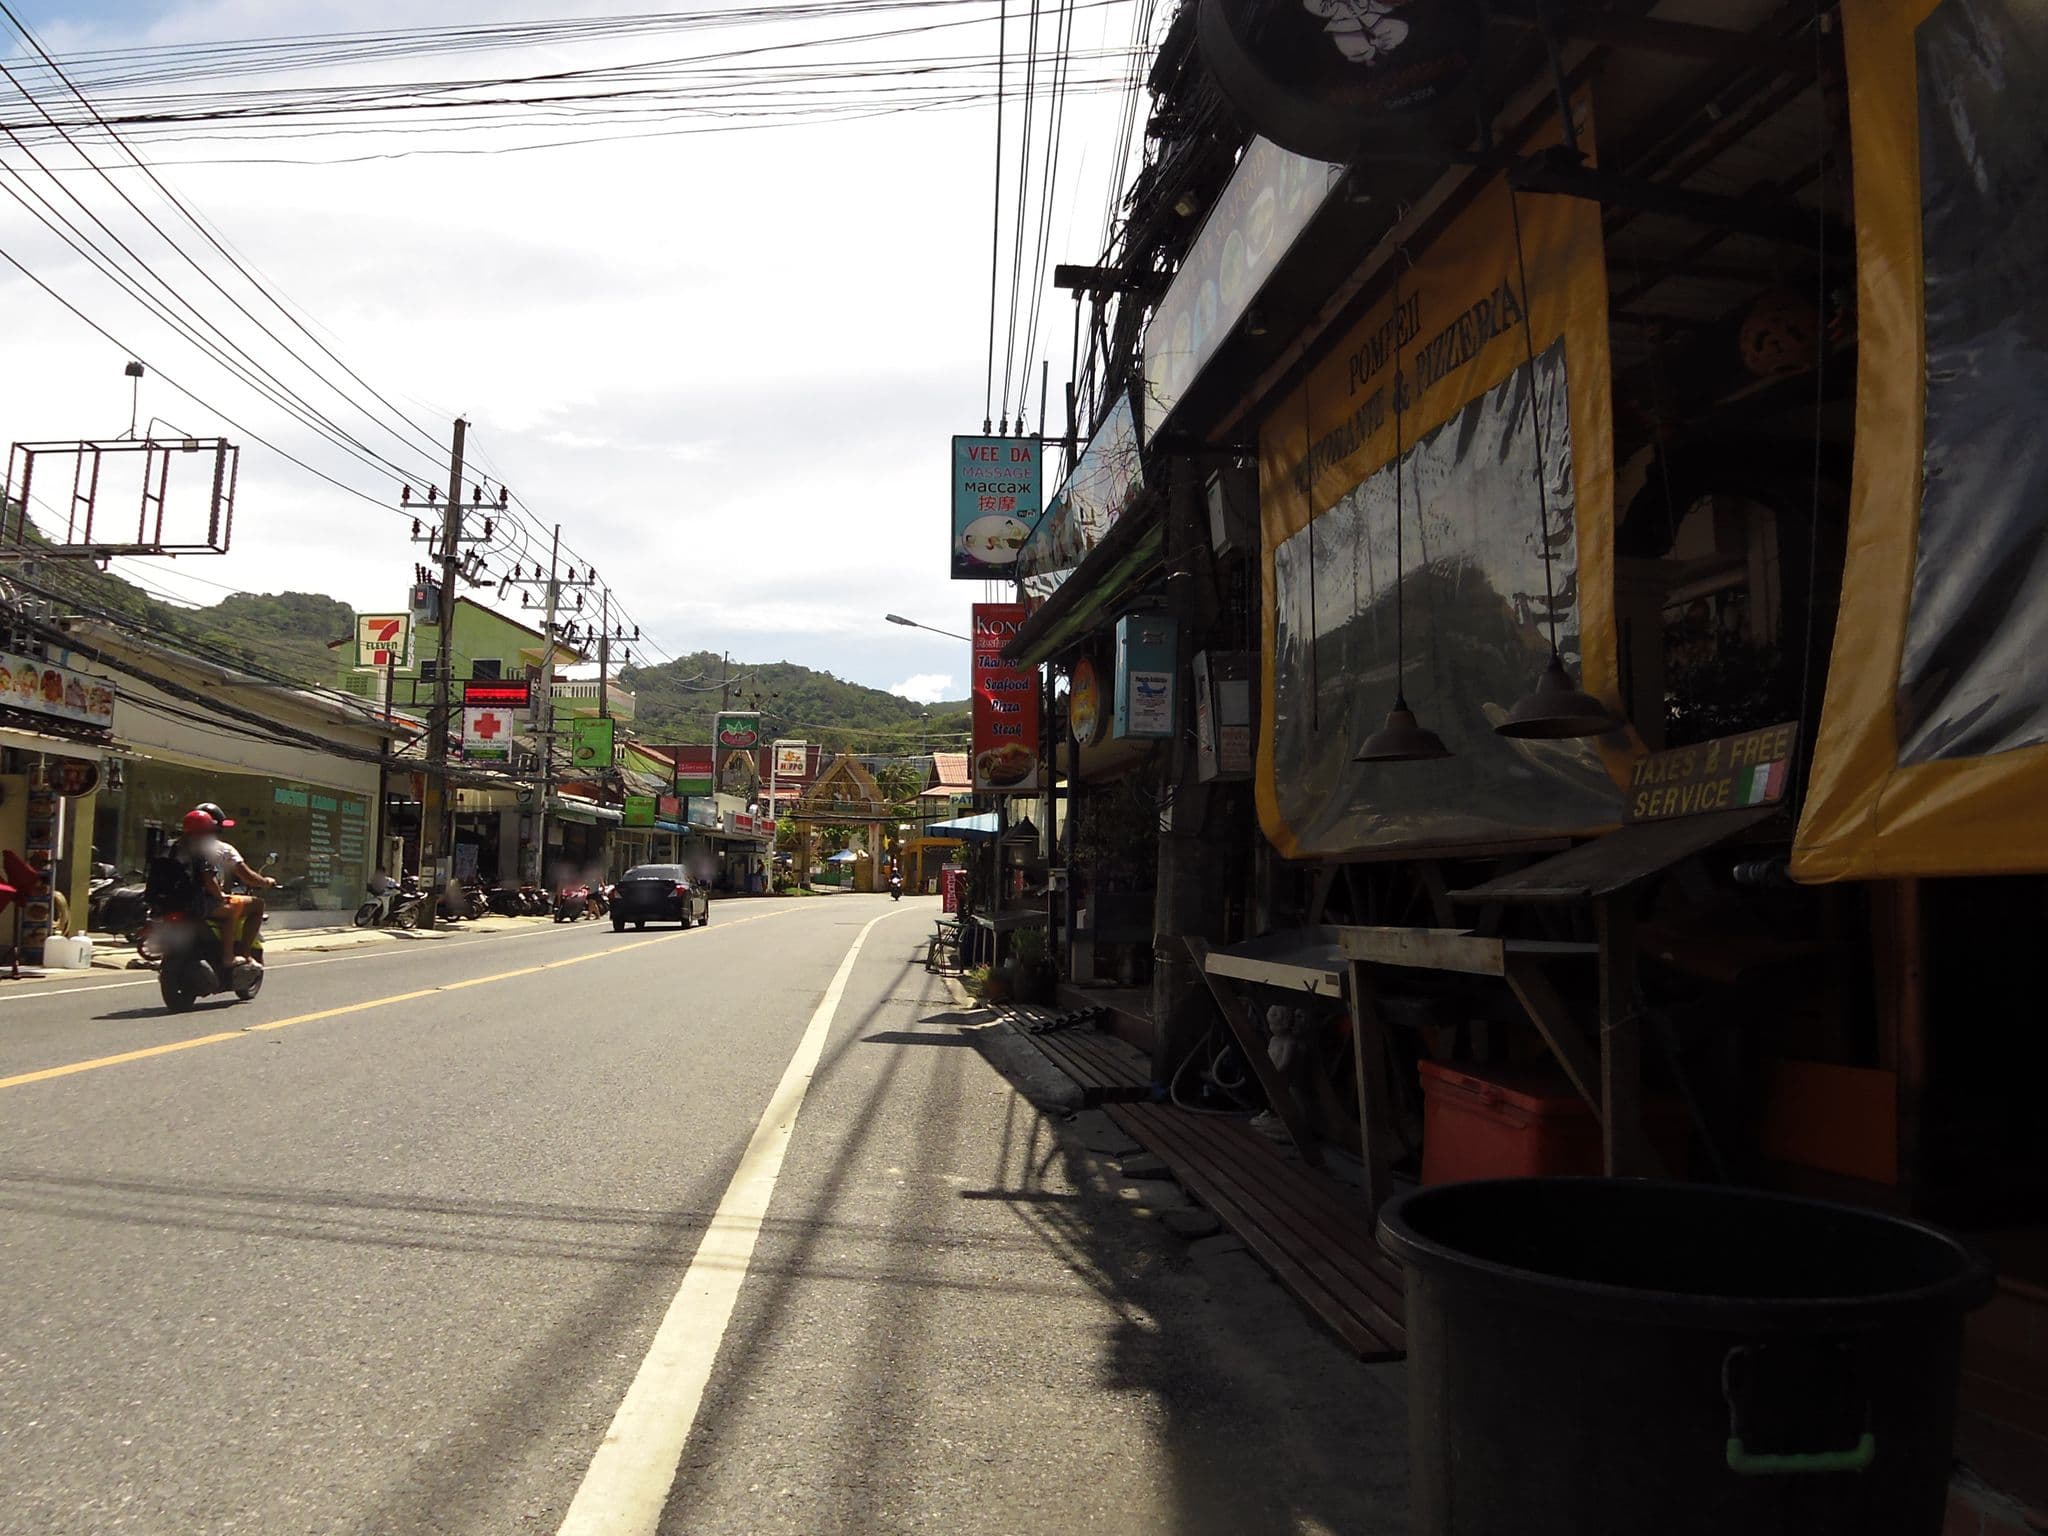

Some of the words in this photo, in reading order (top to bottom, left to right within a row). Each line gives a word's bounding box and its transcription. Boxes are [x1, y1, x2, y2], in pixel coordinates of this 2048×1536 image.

[1348, 289, 1422, 396] POMPEII
[1415, 276, 1524, 398] PIZZERIA
[968, 446, 1000, 462] VEE
[1010, 447, 1032, 463] DA
[962, 466, 1033, 479] MASSAGE
[965, 482, 1032, 494] массаж
[978, 495, 1016, 511] 按摩
[368, 620, 400, 664] 7
[978, 655, 1001, 669] Thai
[984, 676, 1030, 693] Seafood
[991, 698, 1021, 713] Pizza
[992, 721, 1022, 738] Steak
[1633, 750, 1696, 785] TAXES
[1729, 728, 1791, 769] FREE
[1633, 778, 1732, 817] SERVICE
